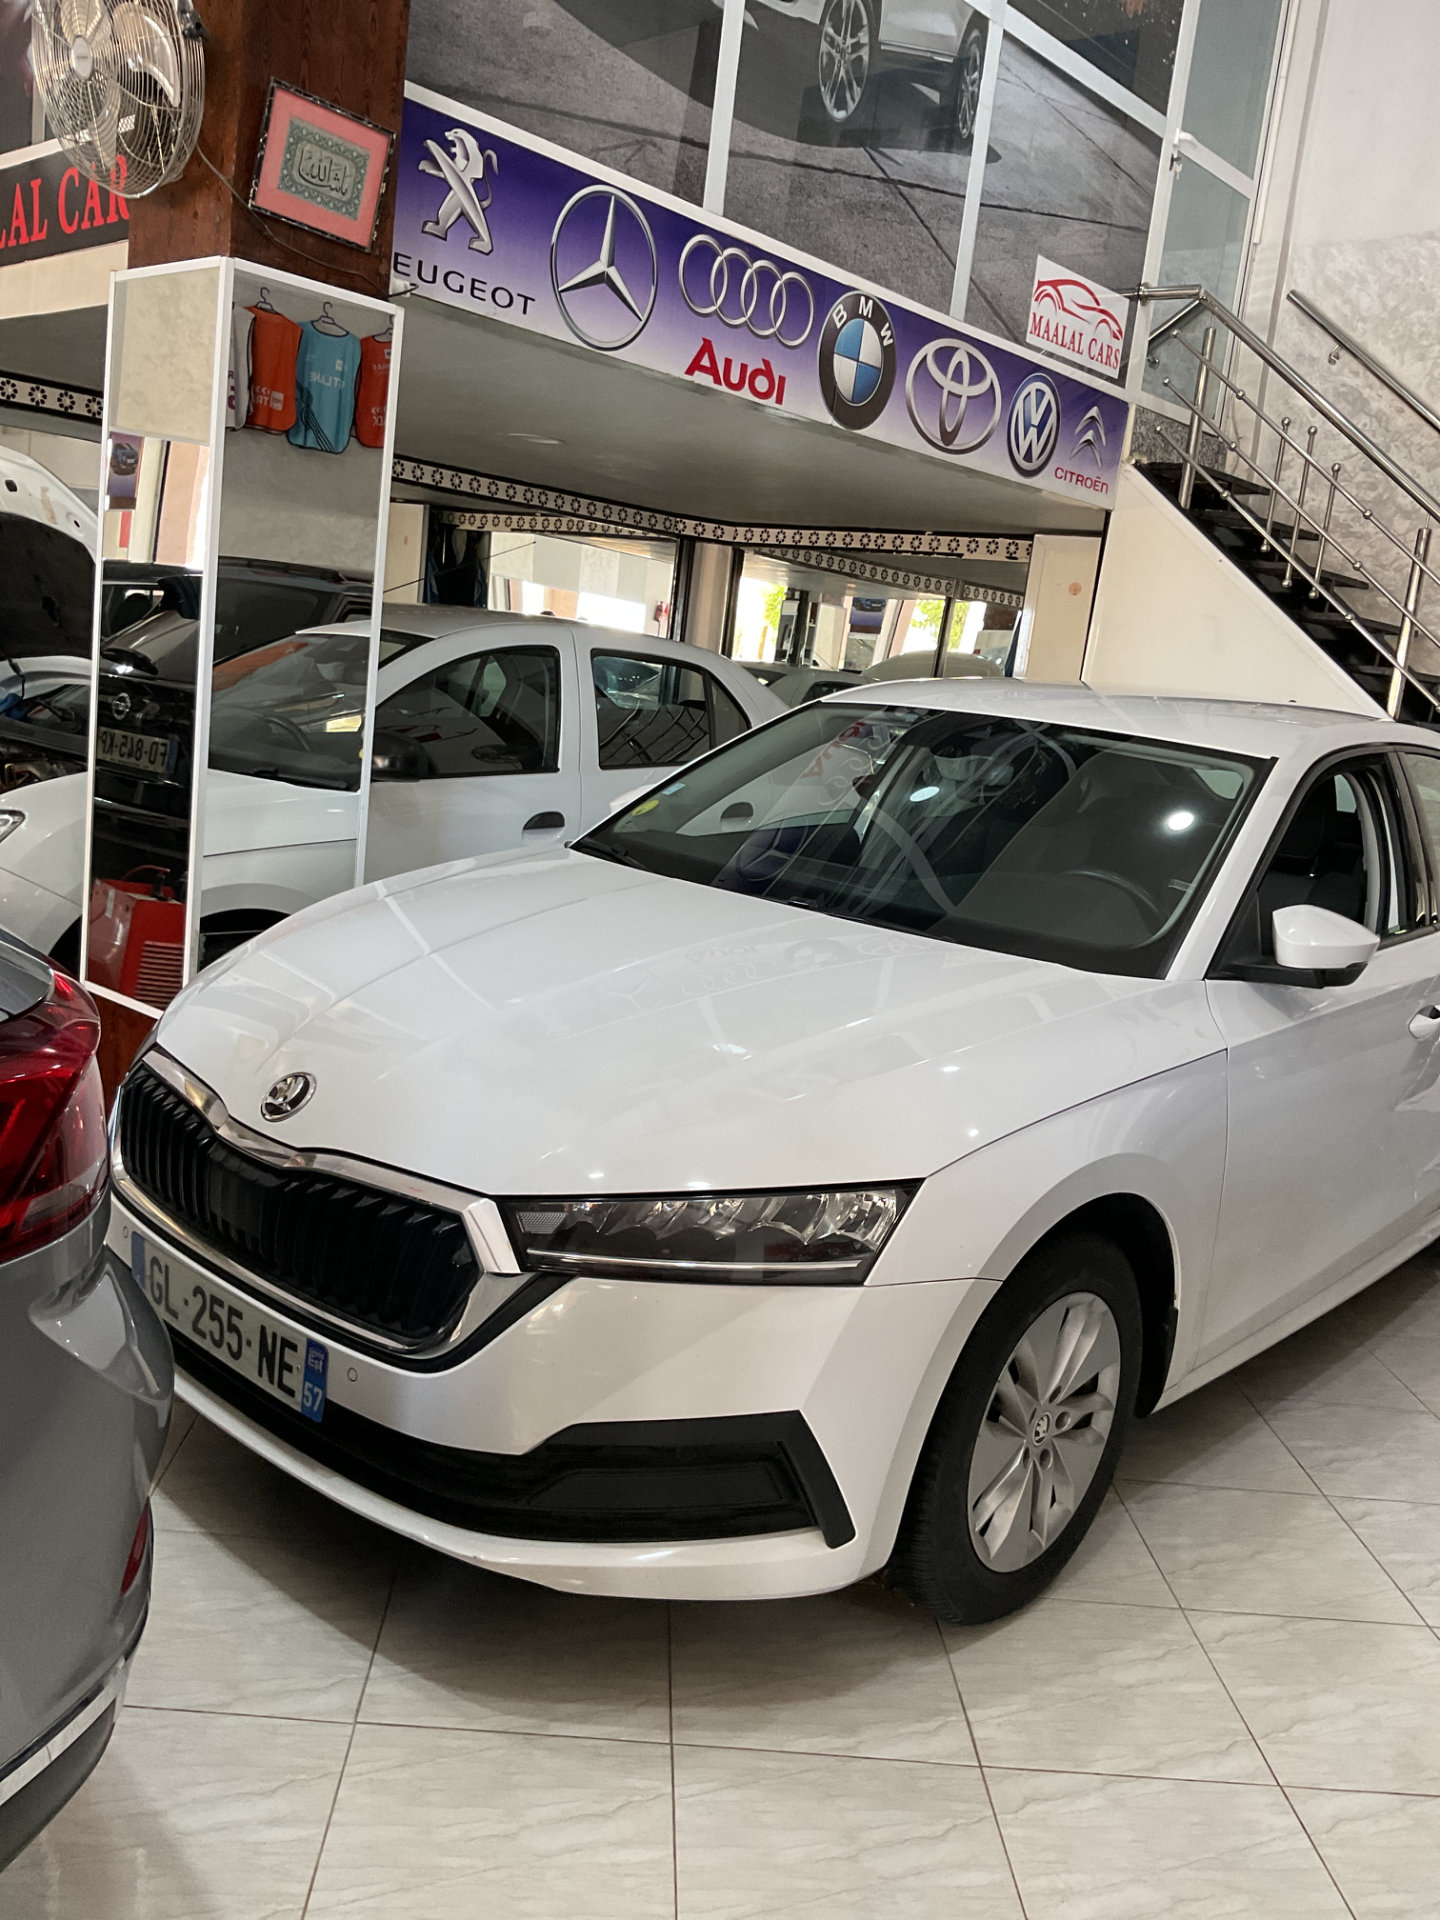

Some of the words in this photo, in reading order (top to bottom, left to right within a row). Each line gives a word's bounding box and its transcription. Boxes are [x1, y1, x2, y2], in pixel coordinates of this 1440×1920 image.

[1029, 312, 1085, 356] MAALAL
[1088, 337, 1120, 371] CARS
[149, 1255, 299, 1399] GL-255-NE
[303, 1381, 323, 1412] 57
